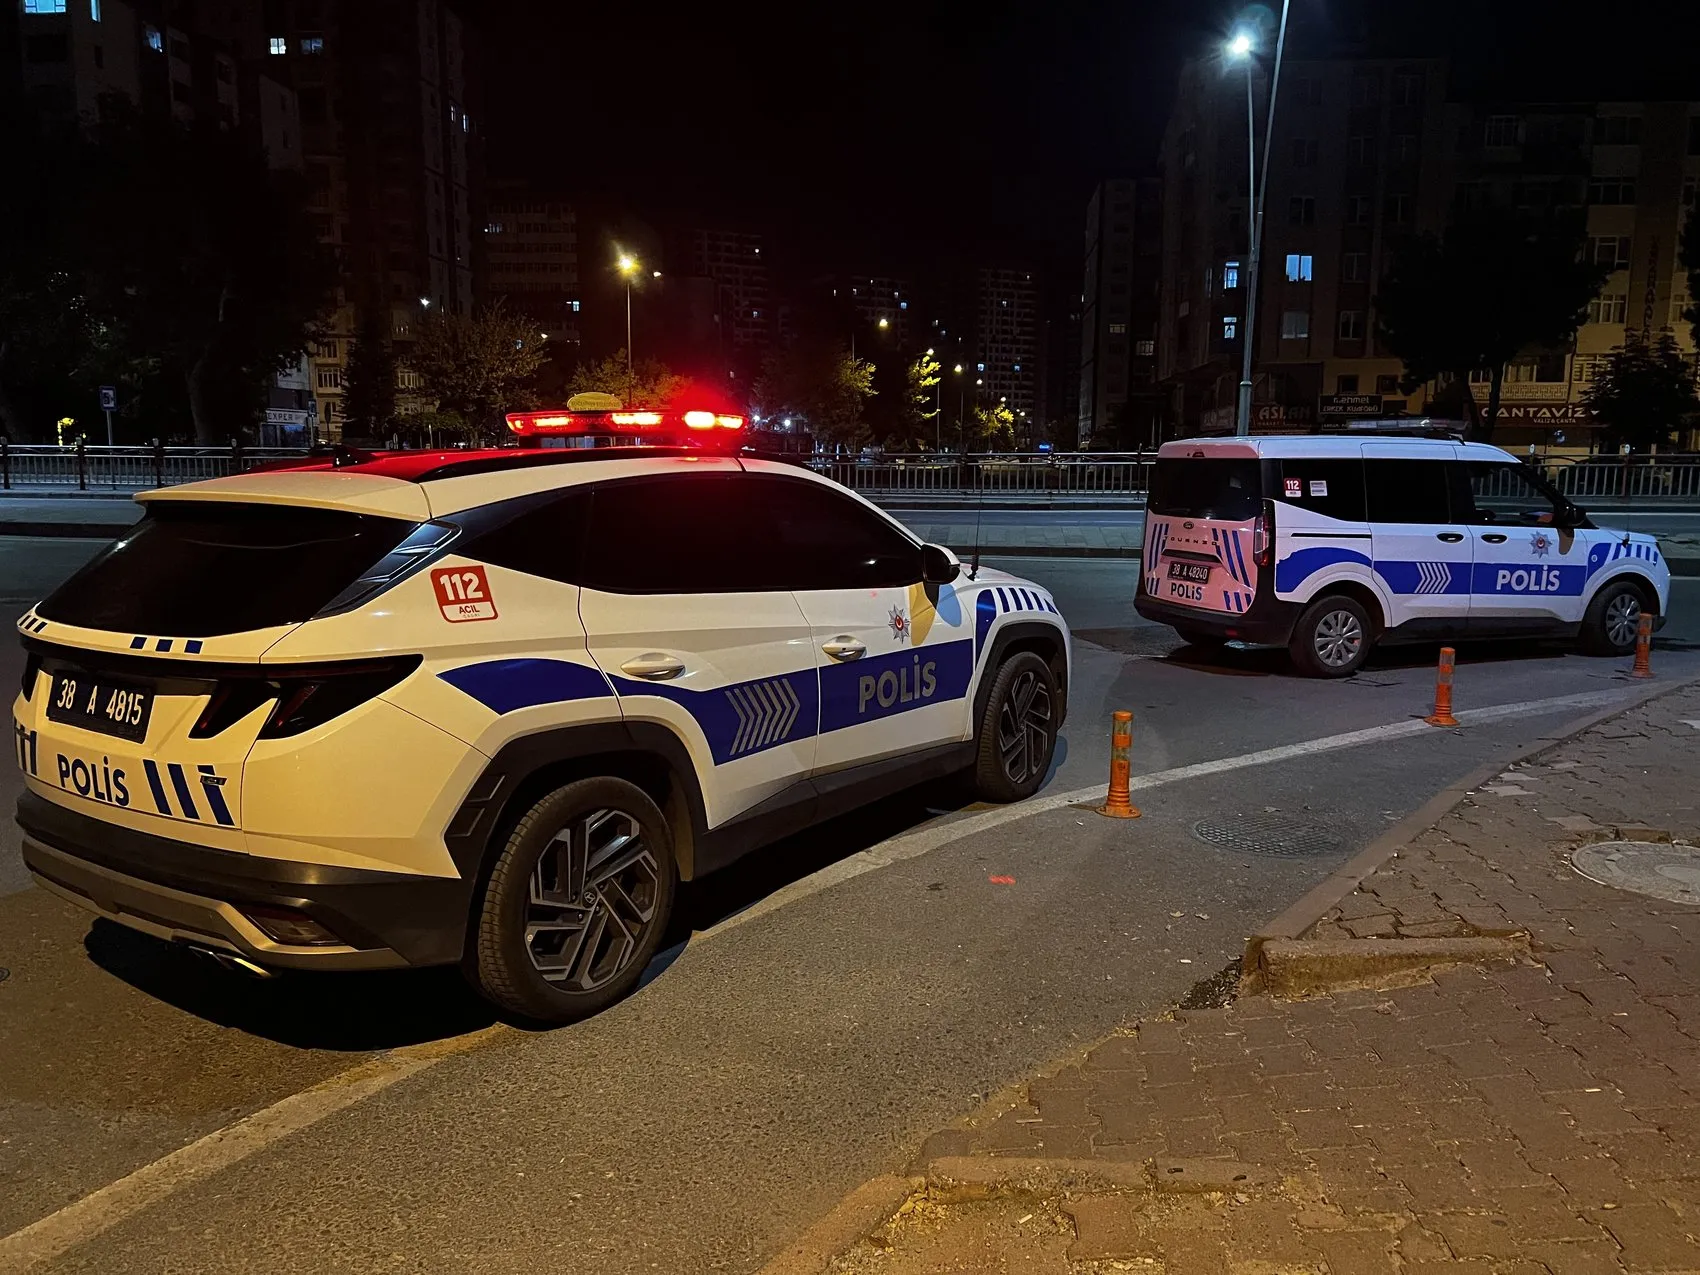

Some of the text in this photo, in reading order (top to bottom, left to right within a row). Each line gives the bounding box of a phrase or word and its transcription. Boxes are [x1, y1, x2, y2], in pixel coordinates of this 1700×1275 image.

[1286, 480, 1300, 490] 112
[1172, 564, 1181, 575] 38
[1182, 565, 1188, 577] A
[1496, 564, 1561, 592] POLİS
[440, 572, 484, 601] 112
[858, 654, 938, 714] POLİS
[57, 678, 145, 726] 38 A 4815
[57, 753, 130, 807] POLİS
